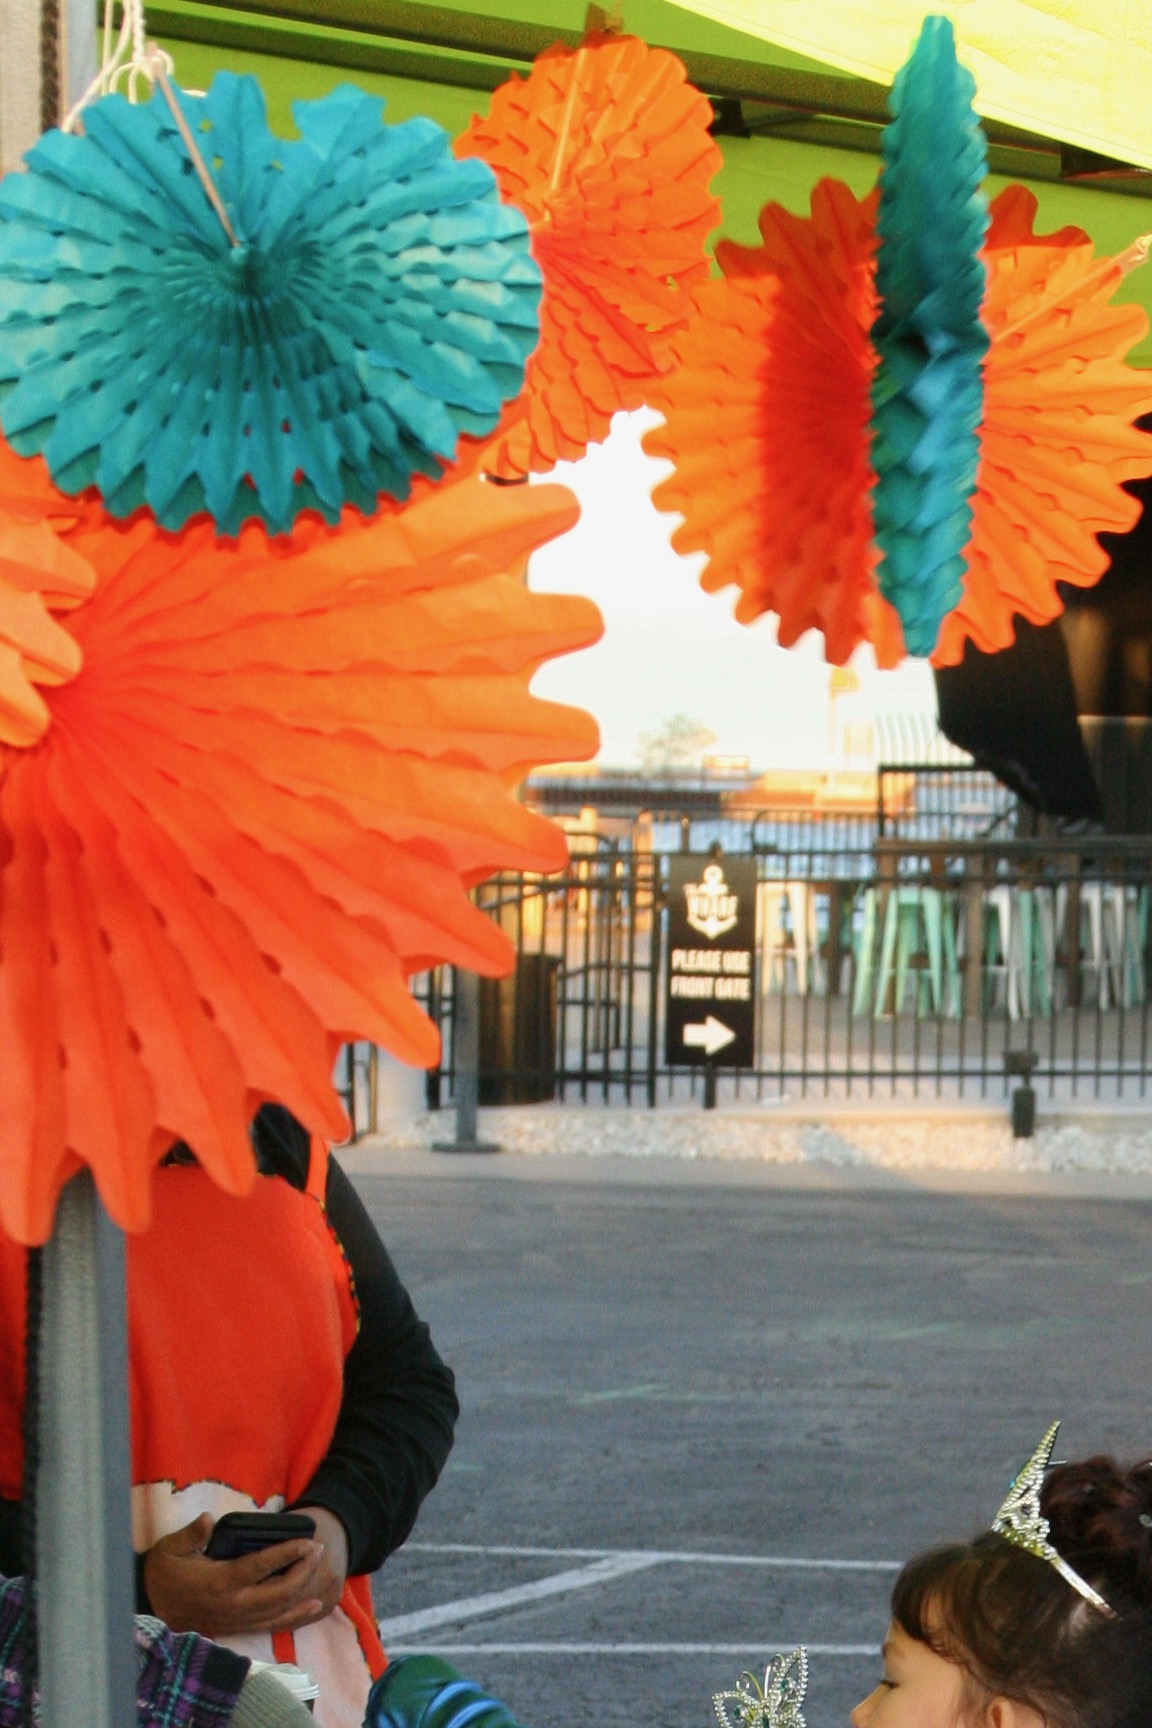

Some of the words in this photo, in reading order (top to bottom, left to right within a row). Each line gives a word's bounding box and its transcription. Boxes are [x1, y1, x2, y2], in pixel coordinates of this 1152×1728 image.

[671, 949, 722, 973] PLEASE
[722, 951, 751, 975] USE
[670, 975, 715, 999] FRONT
[715, 977, 751, 1001] GATE
